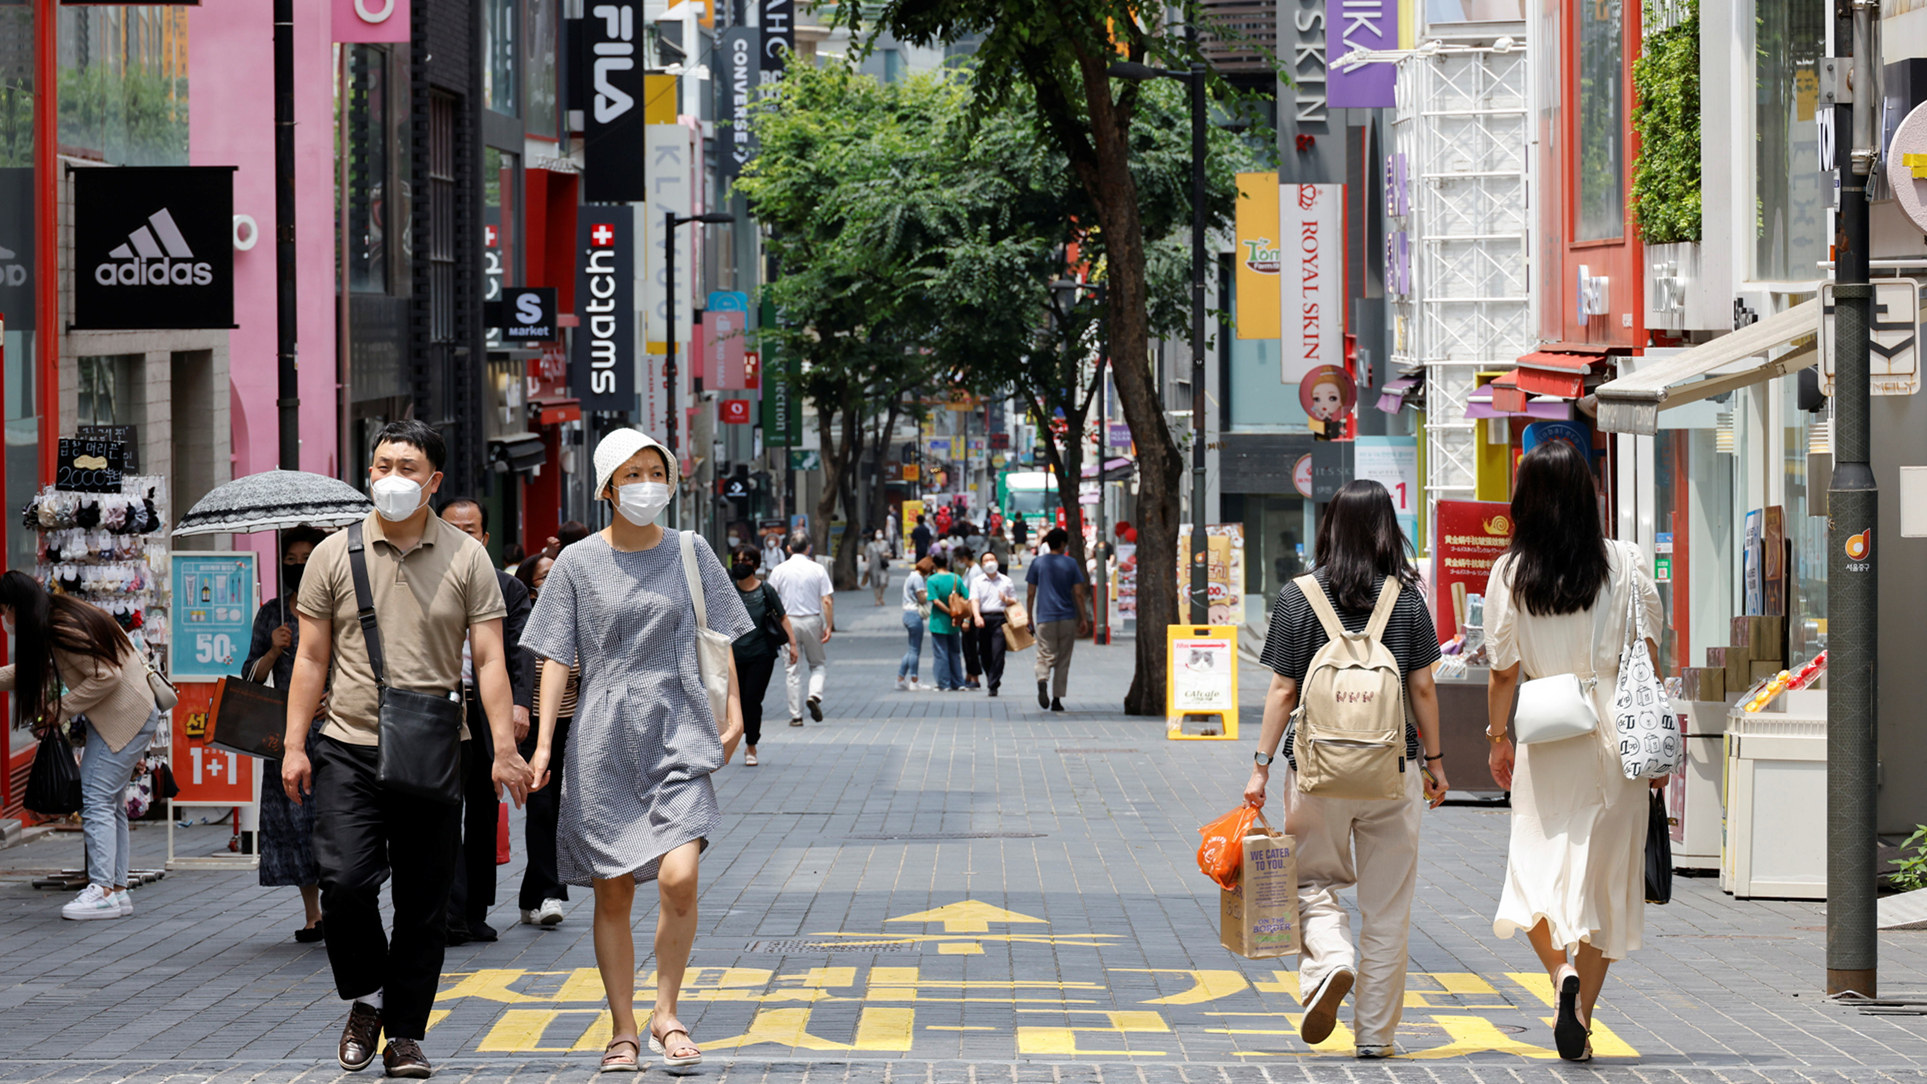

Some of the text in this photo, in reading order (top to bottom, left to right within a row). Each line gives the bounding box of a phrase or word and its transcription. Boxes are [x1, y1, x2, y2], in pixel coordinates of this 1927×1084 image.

[593, 5, 634, 125] FILA
[1295, 10, 1326, 122] SKIN
[733, 38, 749, 143] CONVERSE
[94, 257, 213, 287] adidas
[1301, 220, 1320, 360] ROYAL SKIN
[515, 293, 543, 325] S
[585, 250, 616, 394] swatch
[1873, 382, 1917, 393] MOLY
[1845, 563, 1870, 572] 서울중구
[190, 747, 237, 785] 1+1
[1250, 847, 1290, 860] WE CATER
[1255, 861, 1265, 871] TO
[1253, 924, 1291, 934] BORDER
